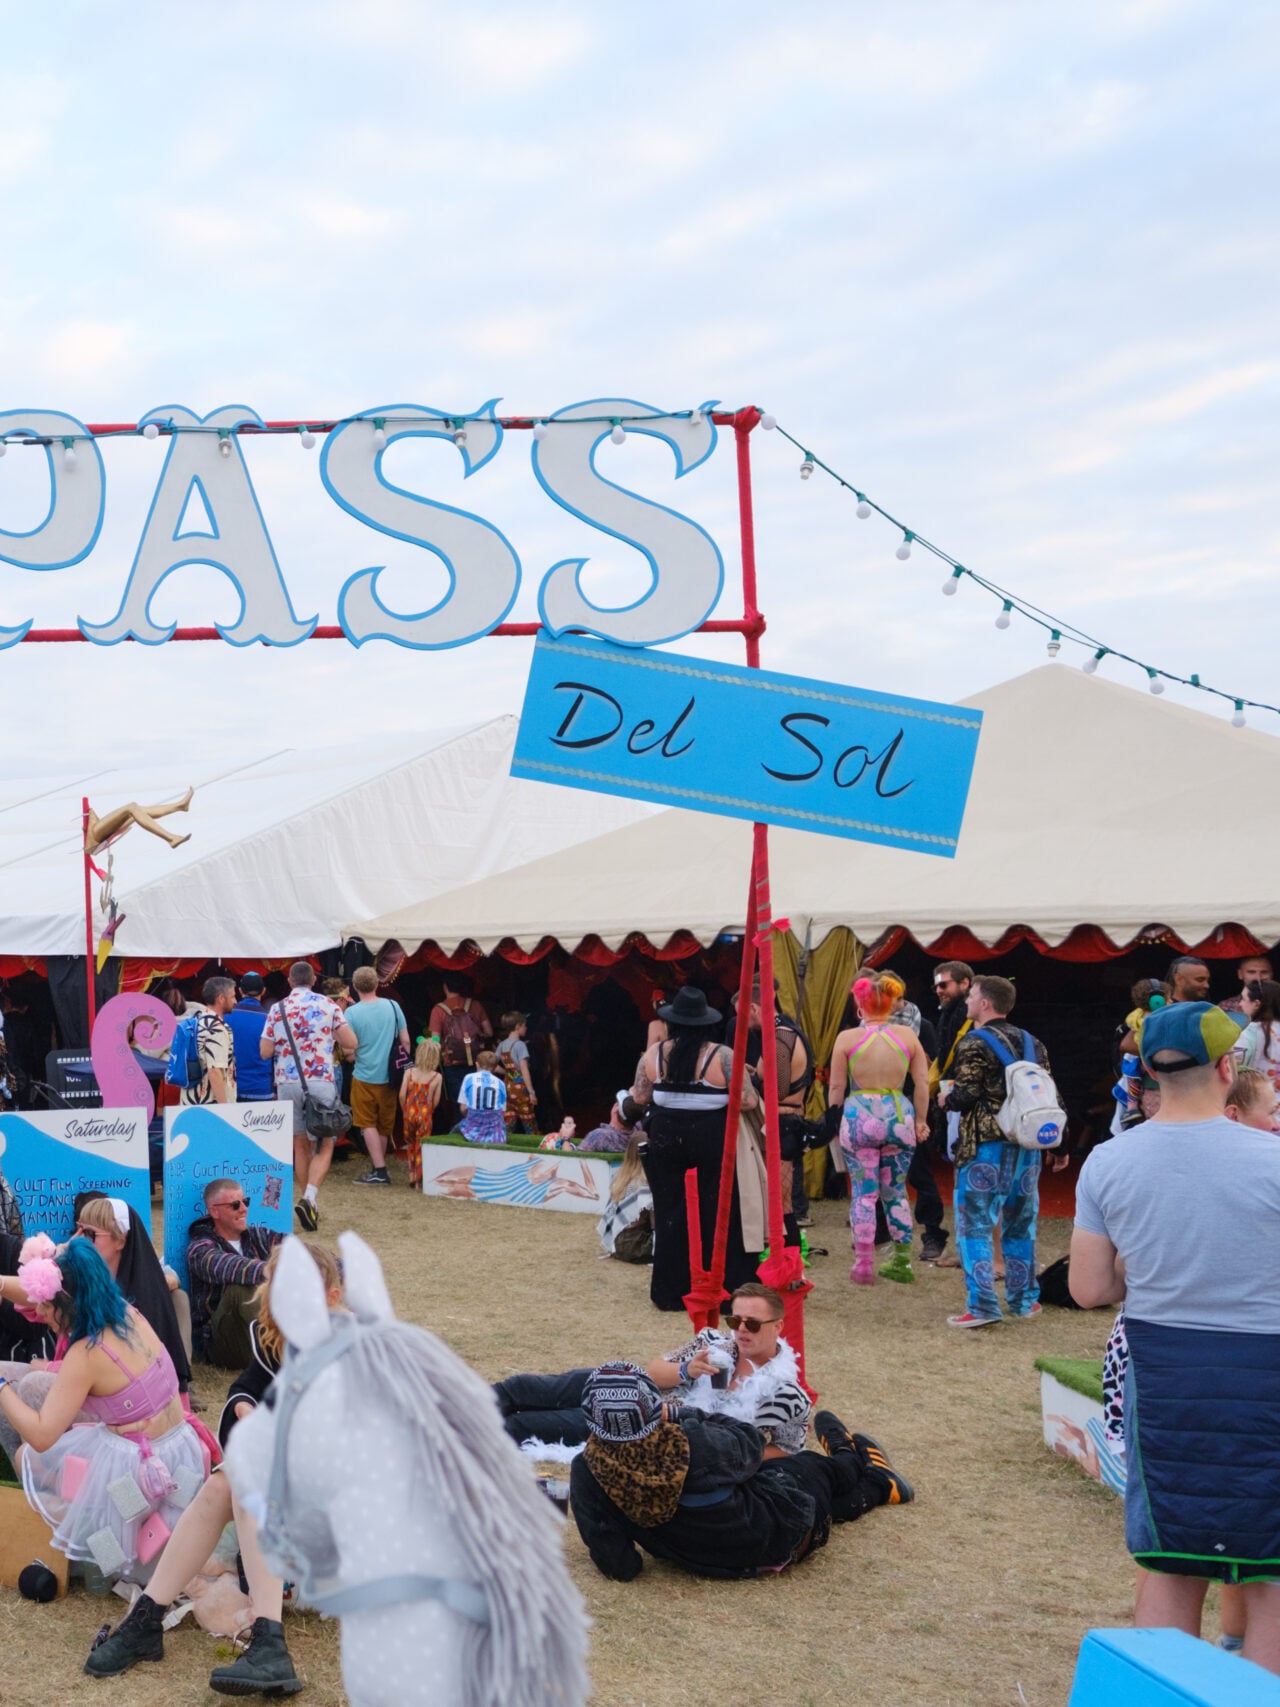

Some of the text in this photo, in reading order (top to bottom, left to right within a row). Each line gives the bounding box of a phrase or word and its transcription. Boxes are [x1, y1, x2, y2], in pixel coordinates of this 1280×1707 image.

[549, 681, 915, 799] Del Sol
[476, 1086, 496, 1110] 10
[242, 1109, 286, 1128] Sunday
[64, 1117, 137, 1142] Saturday
[193, 1162, 219, 1178] CULT
[243, 1159, 285, 1174] SCREENING
[14, 1176, 132, 1192] CULT FILM SCREENING
